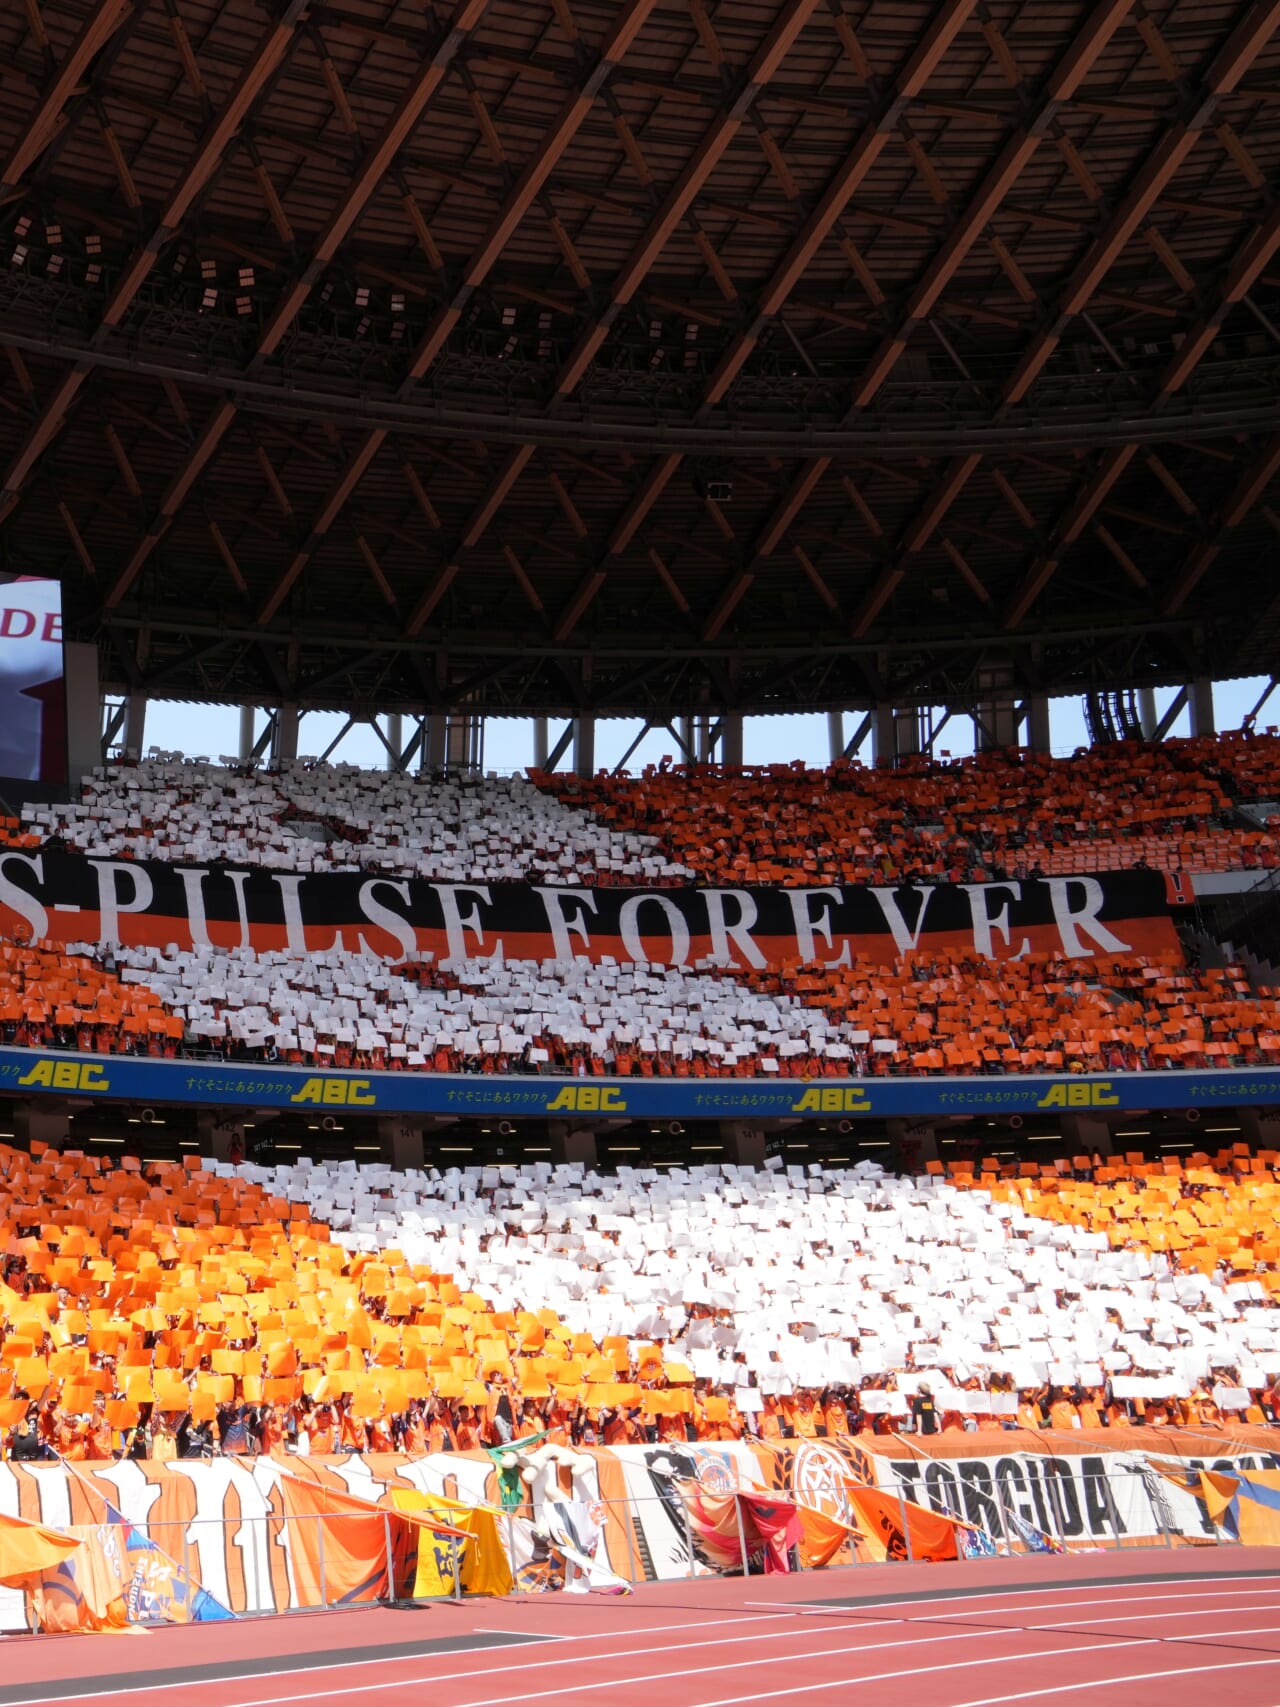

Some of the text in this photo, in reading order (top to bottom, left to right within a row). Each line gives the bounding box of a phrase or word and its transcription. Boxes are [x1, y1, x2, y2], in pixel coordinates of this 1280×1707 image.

[531, 876, 1133, 969] FOREVER
[17, 1059, 111, 1092] ABC
[185, 1077, 377, 1106] すぐそこにあるワクワク ABC
[446, 1086, 628, 1112] すぐそこにあるワクワク ABC
[694, 1087, 872, 1112] すぐそこにあるワクワク ABC
[1036, 1082, 1121, 1108] ABC
[890, 1457, 1129, 1540] TORCIDA
